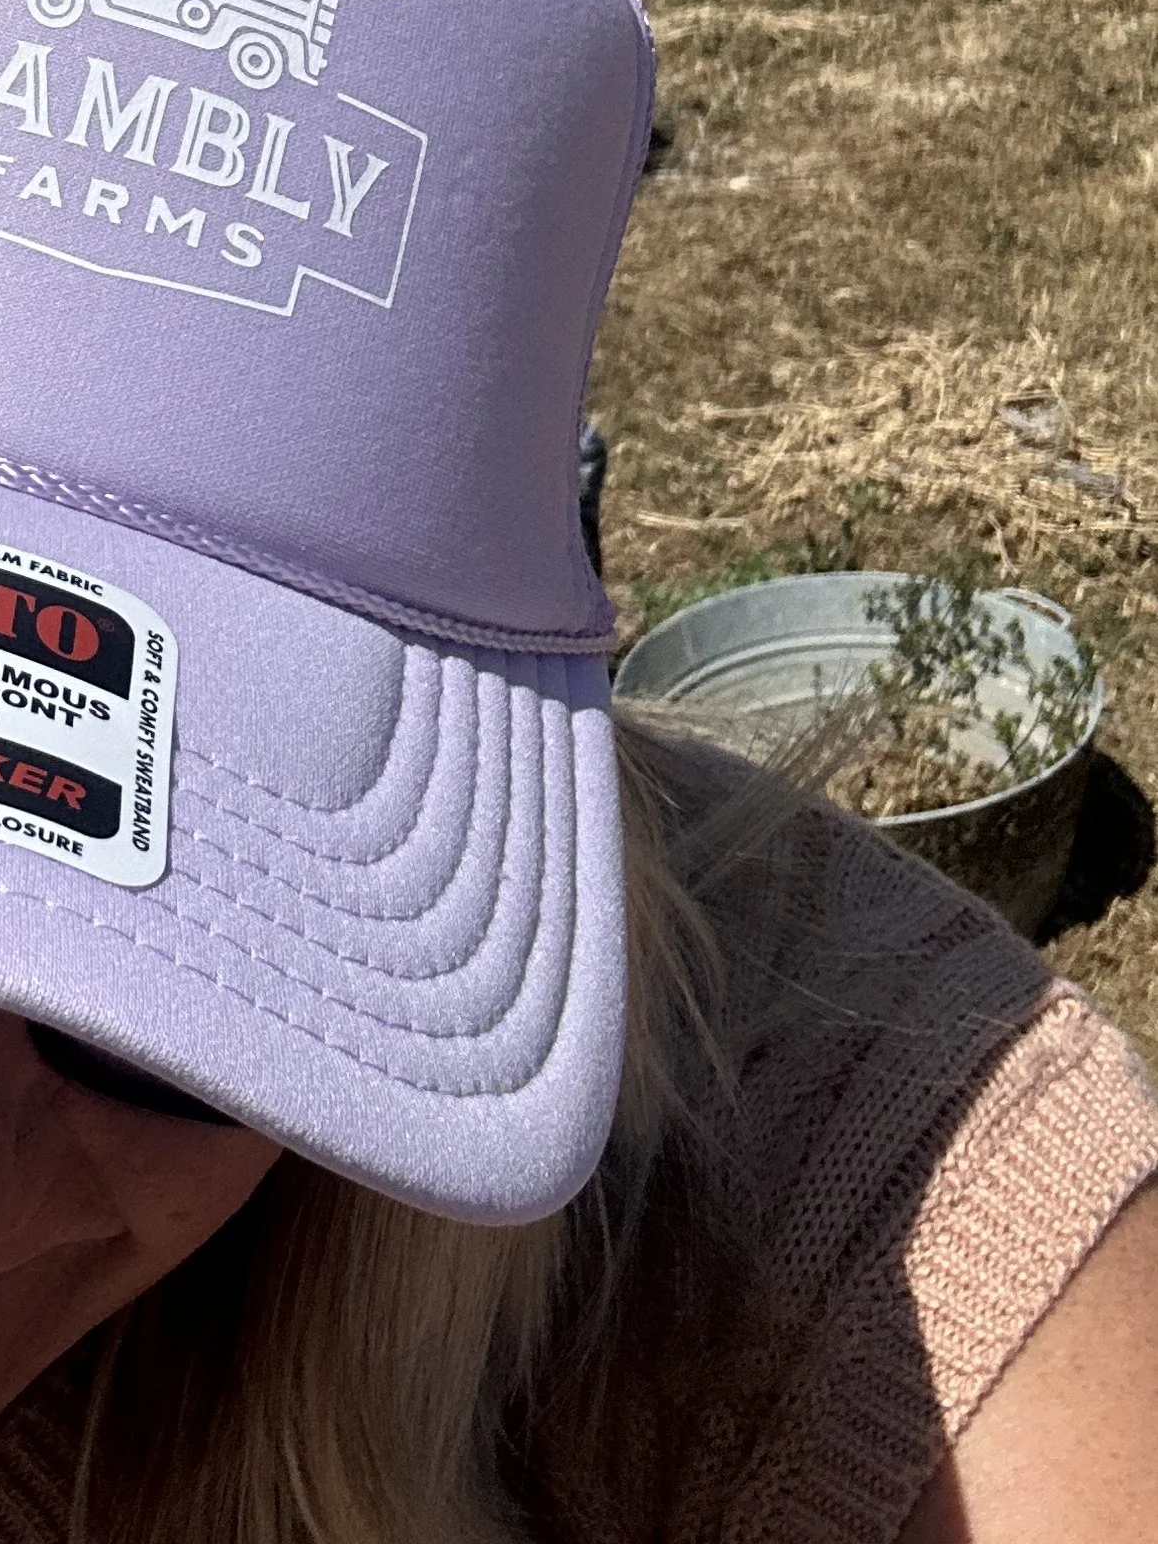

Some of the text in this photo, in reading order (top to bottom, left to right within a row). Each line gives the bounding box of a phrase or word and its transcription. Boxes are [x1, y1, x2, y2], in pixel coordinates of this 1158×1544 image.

[29, 559, 104, 597] FABRIC
[132, 629, 165, 852] SOFT & COMFY SWEATBAND
